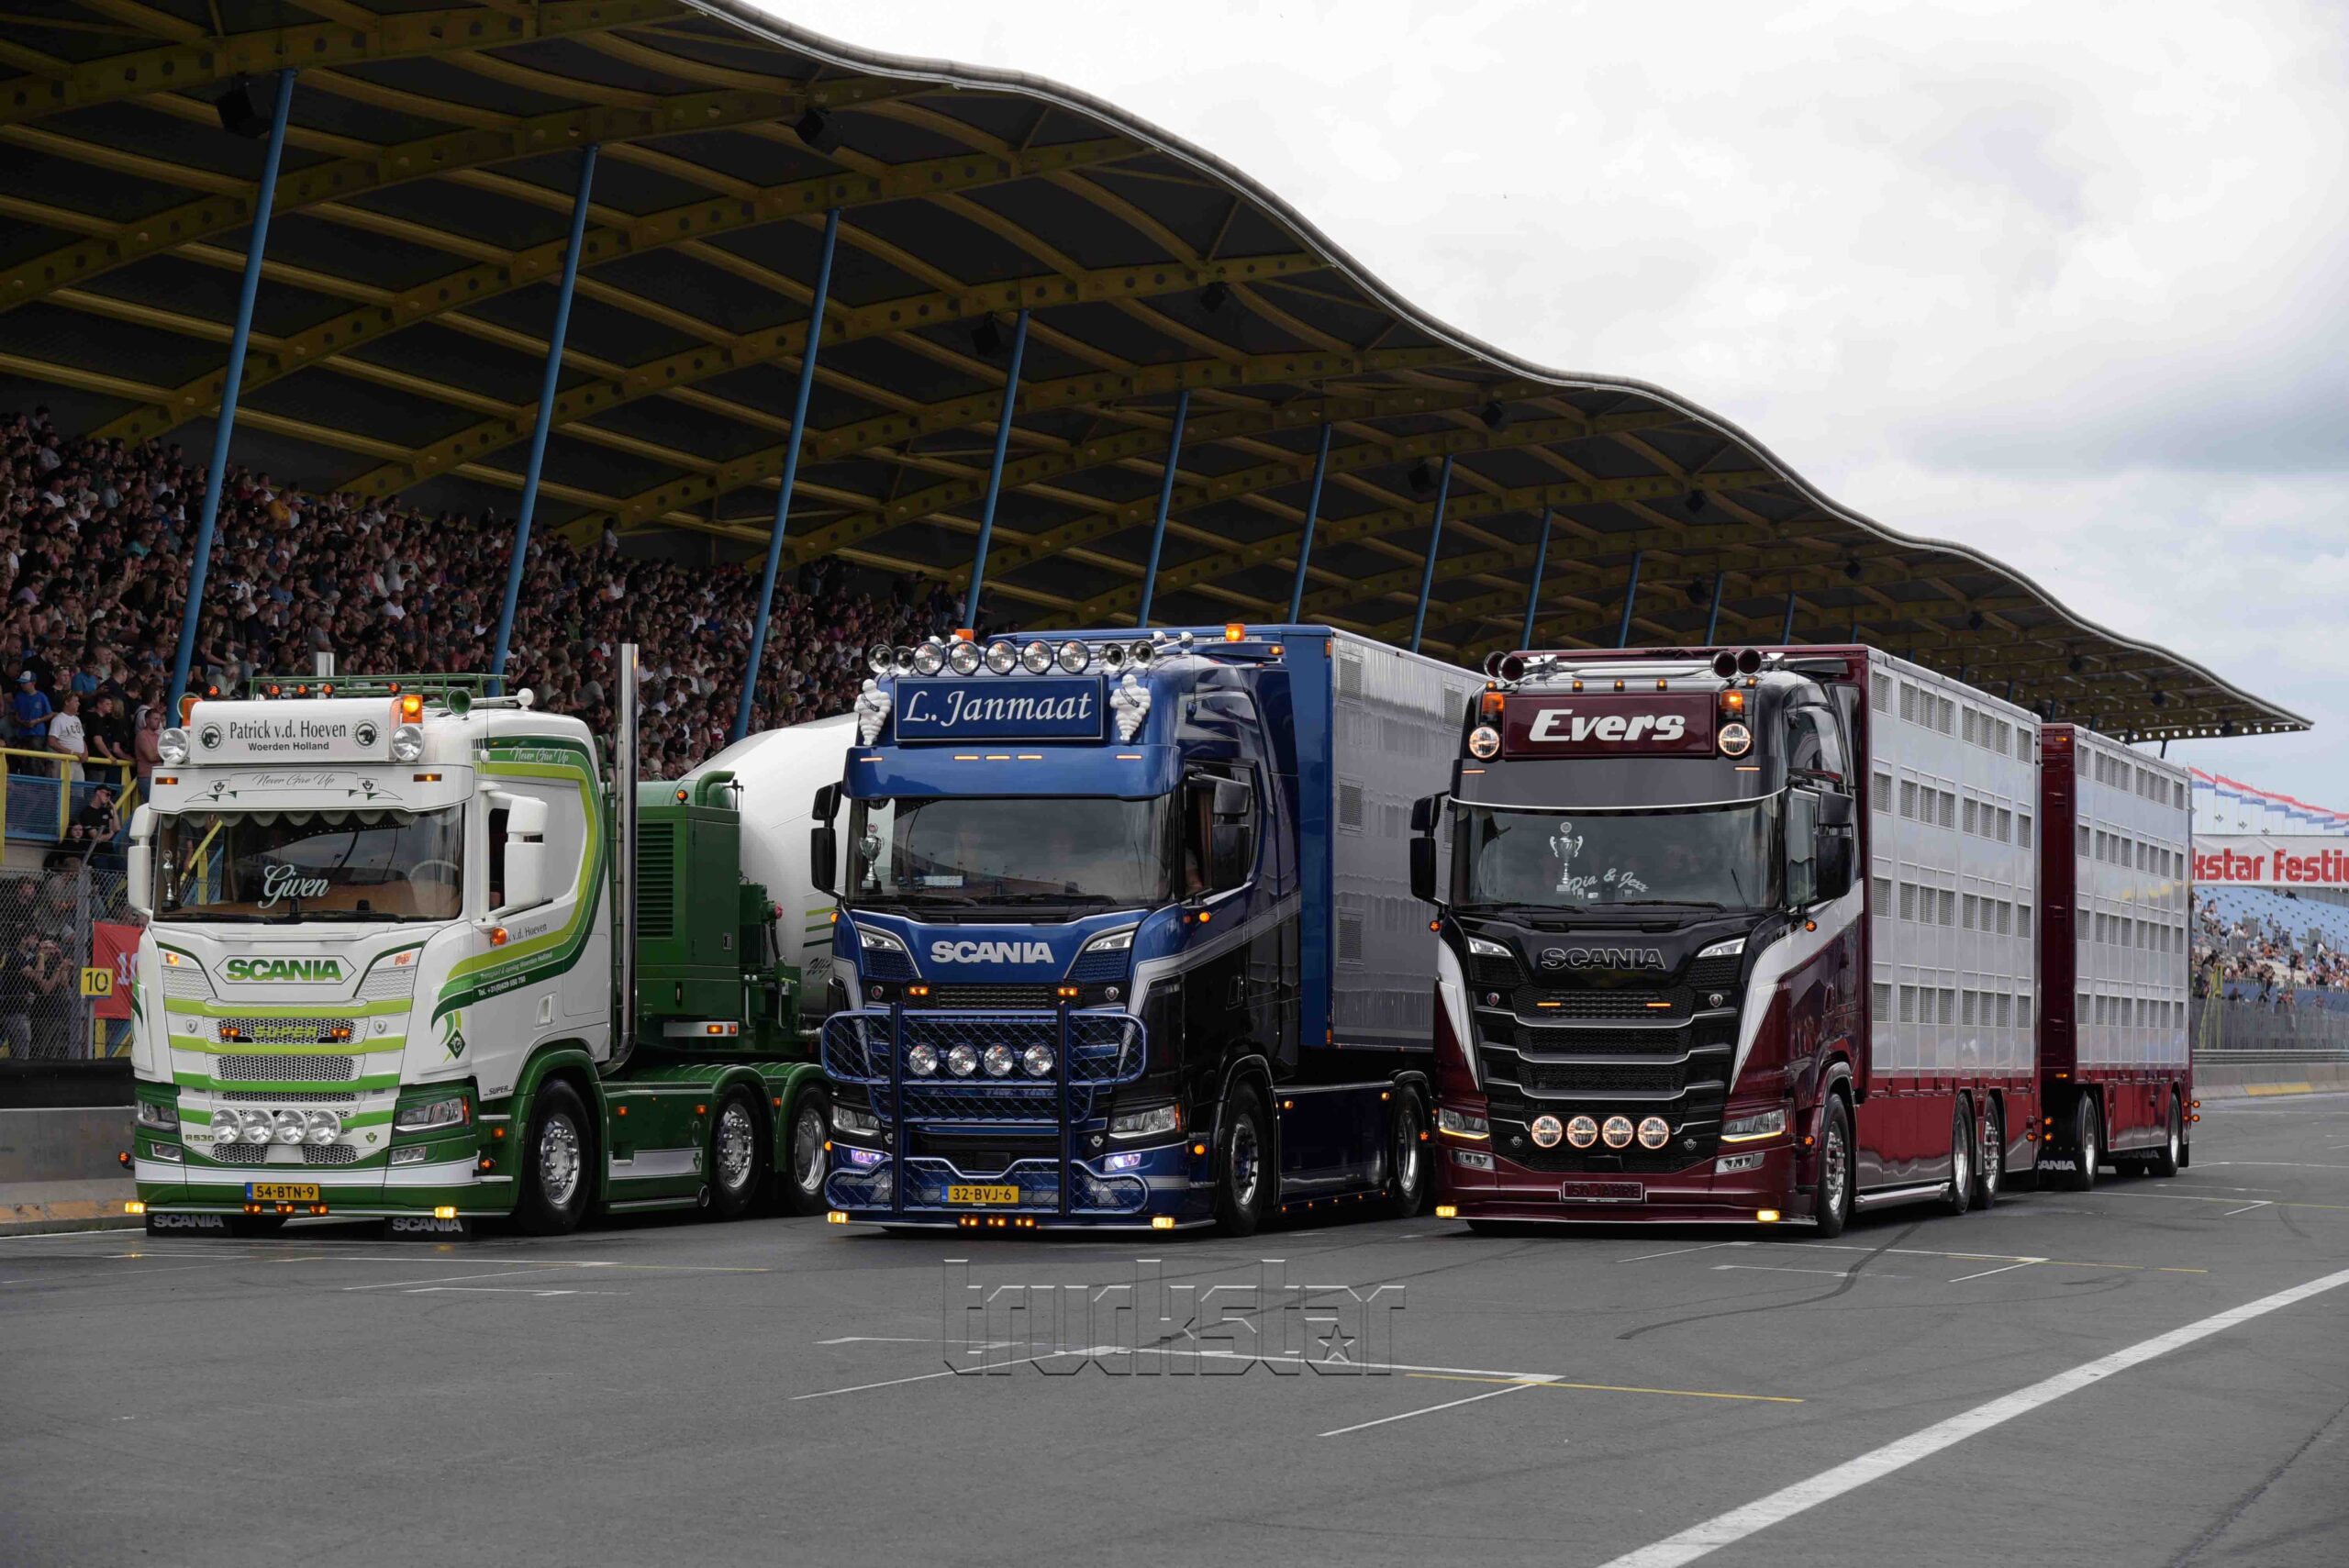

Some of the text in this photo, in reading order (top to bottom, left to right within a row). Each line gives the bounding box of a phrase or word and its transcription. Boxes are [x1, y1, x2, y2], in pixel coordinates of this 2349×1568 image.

[230, 719, 271, 740] Patrick
[274, 719, 296, 739] v.d.
[300, 720, 347, 739] Hoeven
[1529, 708, 1686, 741] Evers
[249, 741, 329, 751] Woerden Holland
[251, 773, 336, 788] Never Give Up
[258, 863, 330, 909] Given
[525, 923, 548, 938] Hoeven
[930, 940, 1055, 963] SCANIA
[1541, 947, 1666, 970] SCANIA
[227, 959, 343, 982] SCANIA
[85, 971, 108, 992] 10
[254, 1026, 318, 1039] SUPER
[489, 1085, 509, 1095] SUPER
[185, 1134, 215, 1142] R530
[2038, 1160, 2077, 1172] ANIA
[257, 1185, 315, 1198] 54-BTN-9
[952, 1187, 1012, 1201] 32-BVJ-6
[153, 1214, 225, 1229] SCANIA
[392, 1218, 463, 1232] SCANIA
